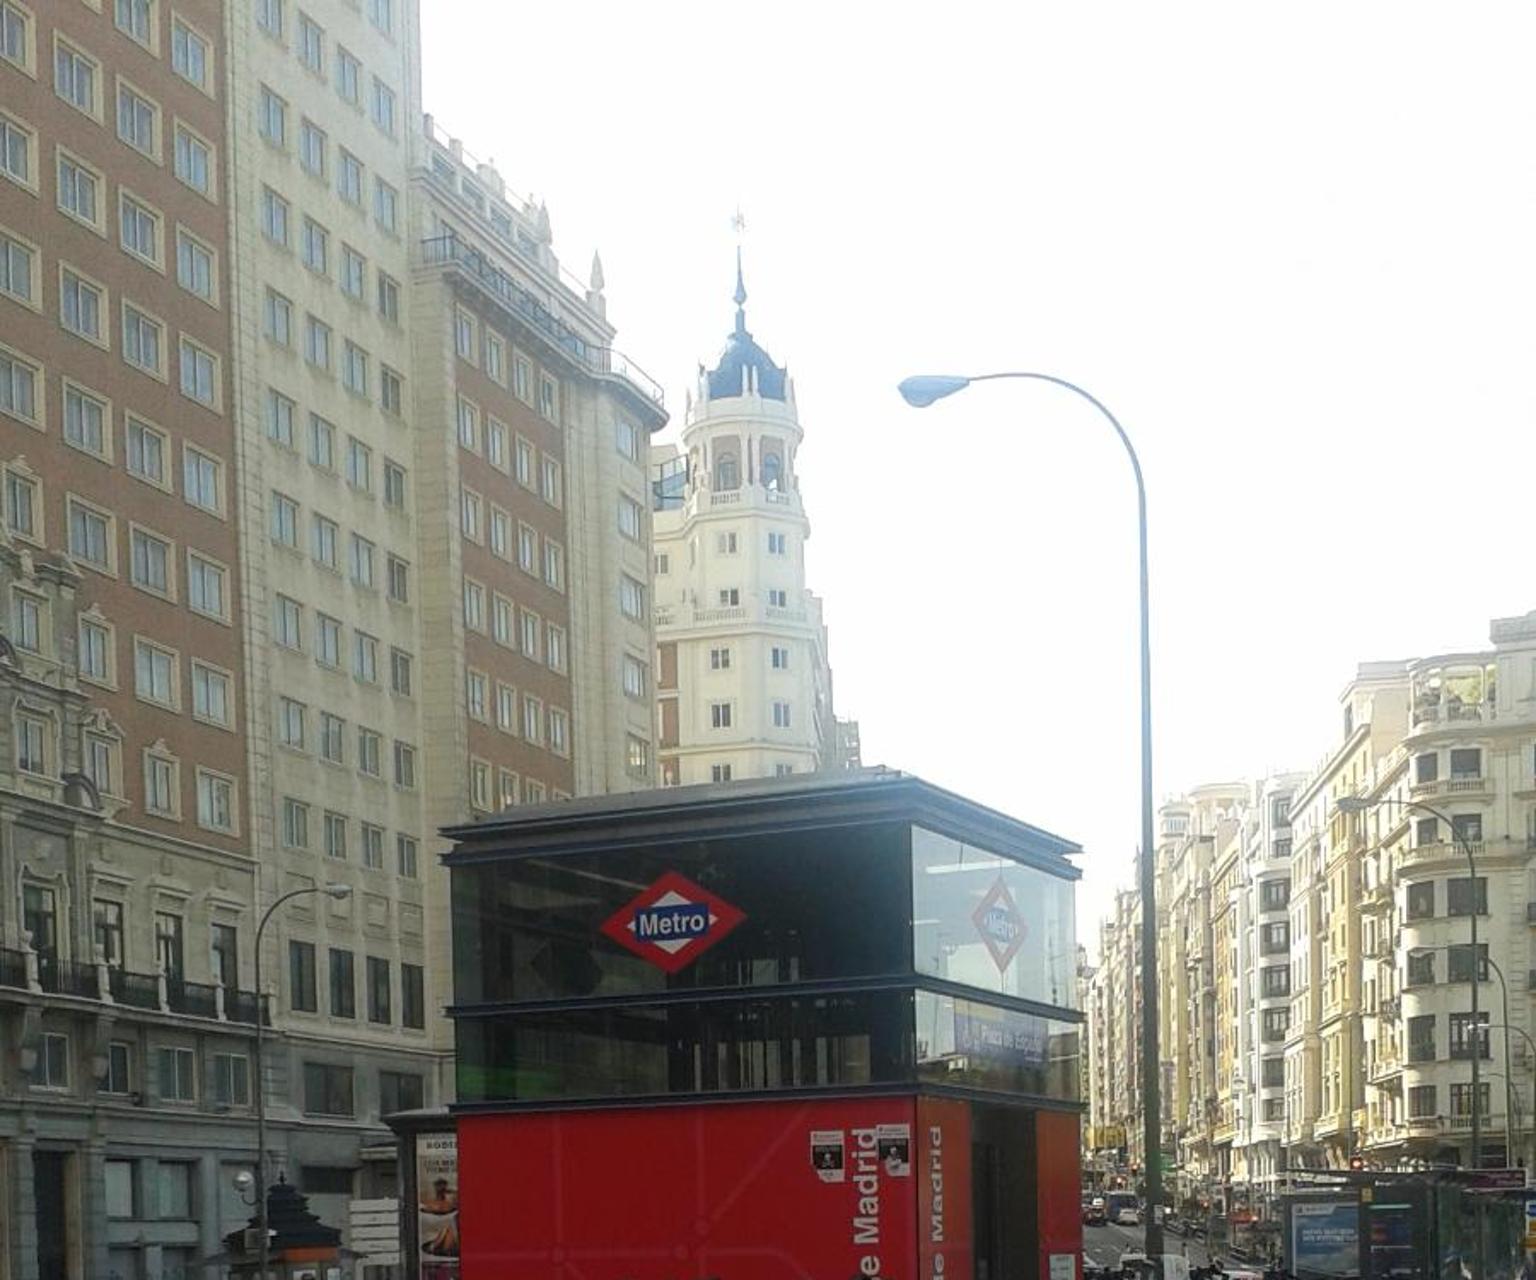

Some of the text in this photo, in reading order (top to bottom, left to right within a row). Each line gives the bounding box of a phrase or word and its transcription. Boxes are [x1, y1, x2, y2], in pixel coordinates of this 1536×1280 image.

[639, 913, 705, 936] Metro
[983, 911, 1015, 938] Metro
[851, 1128, 879, 1244] Madrid
[930, 1126, 944, 1242] Madrid
